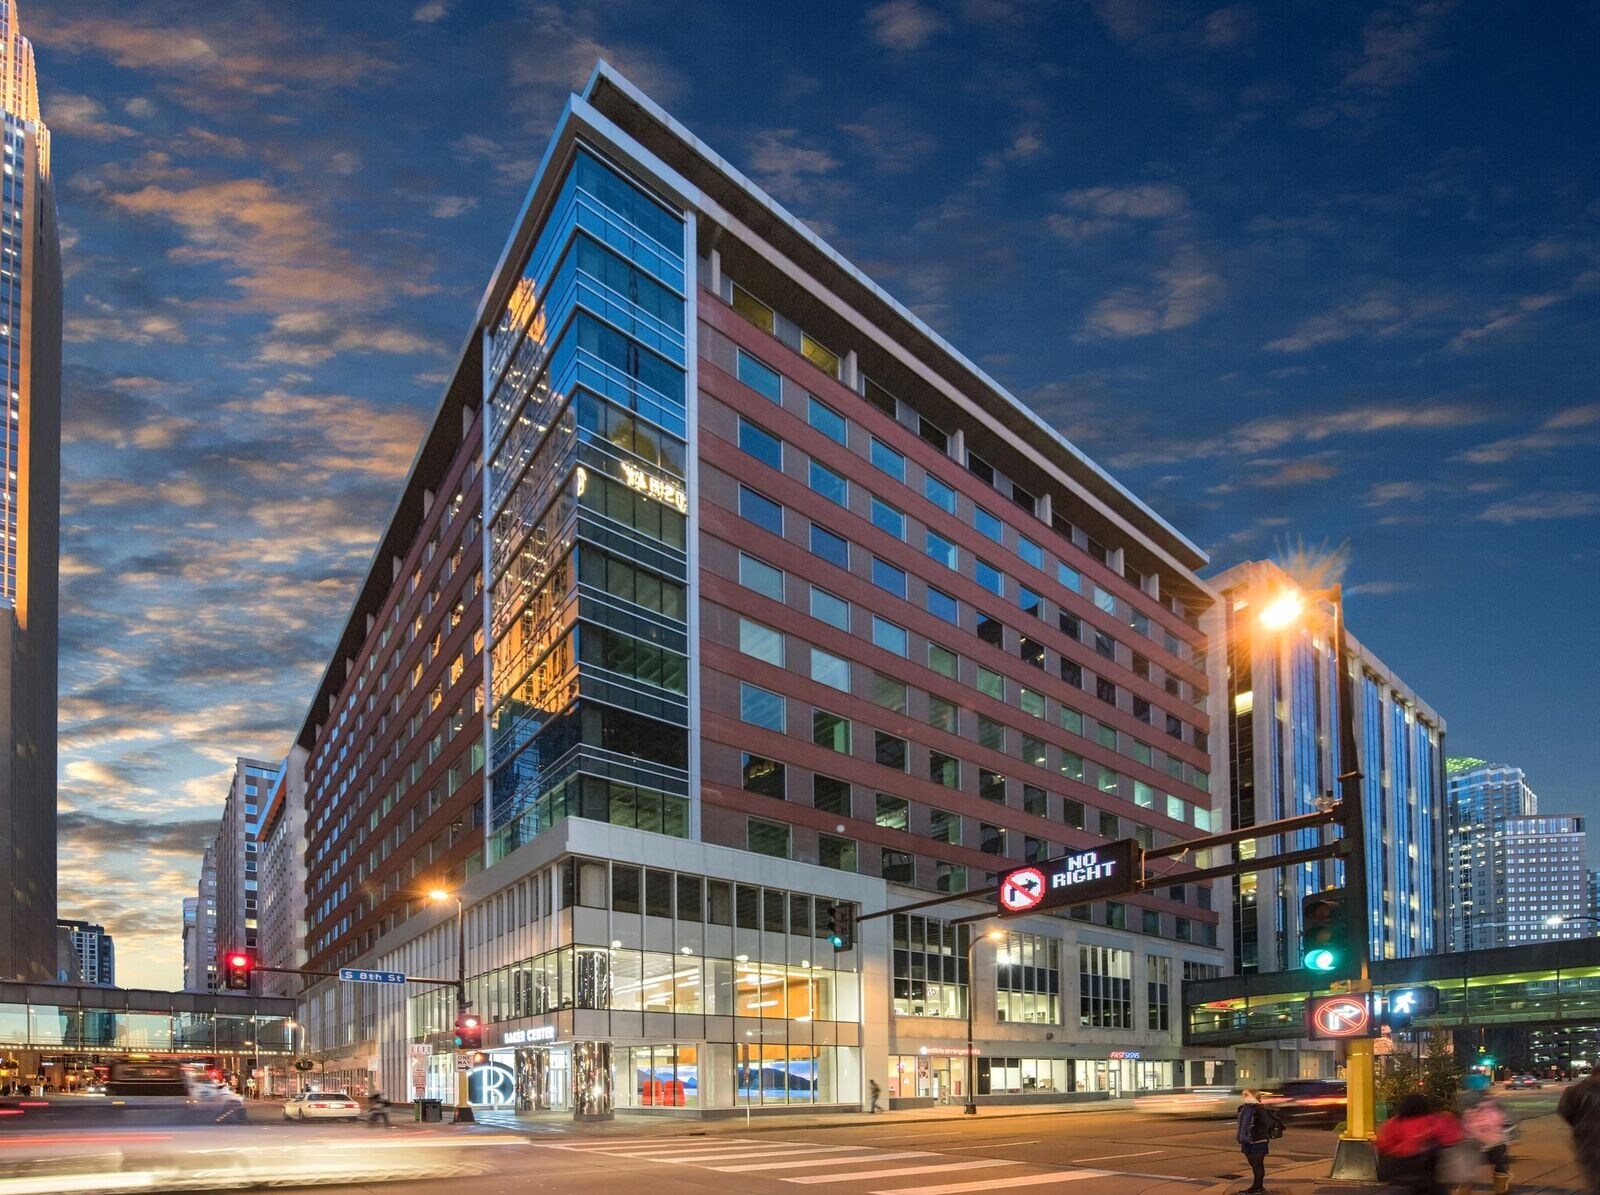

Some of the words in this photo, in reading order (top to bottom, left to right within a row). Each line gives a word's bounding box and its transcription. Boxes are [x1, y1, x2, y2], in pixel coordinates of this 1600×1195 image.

[1068, 852, 1097, 871] NO
[1052, 860, 1116, 888] RIGHT
[345, 971, 353, 979] S
[359, 972, 383, 981] 8th
[388, 974, 402, 982] St
[526, 1026, 555, 1042] CENTER
